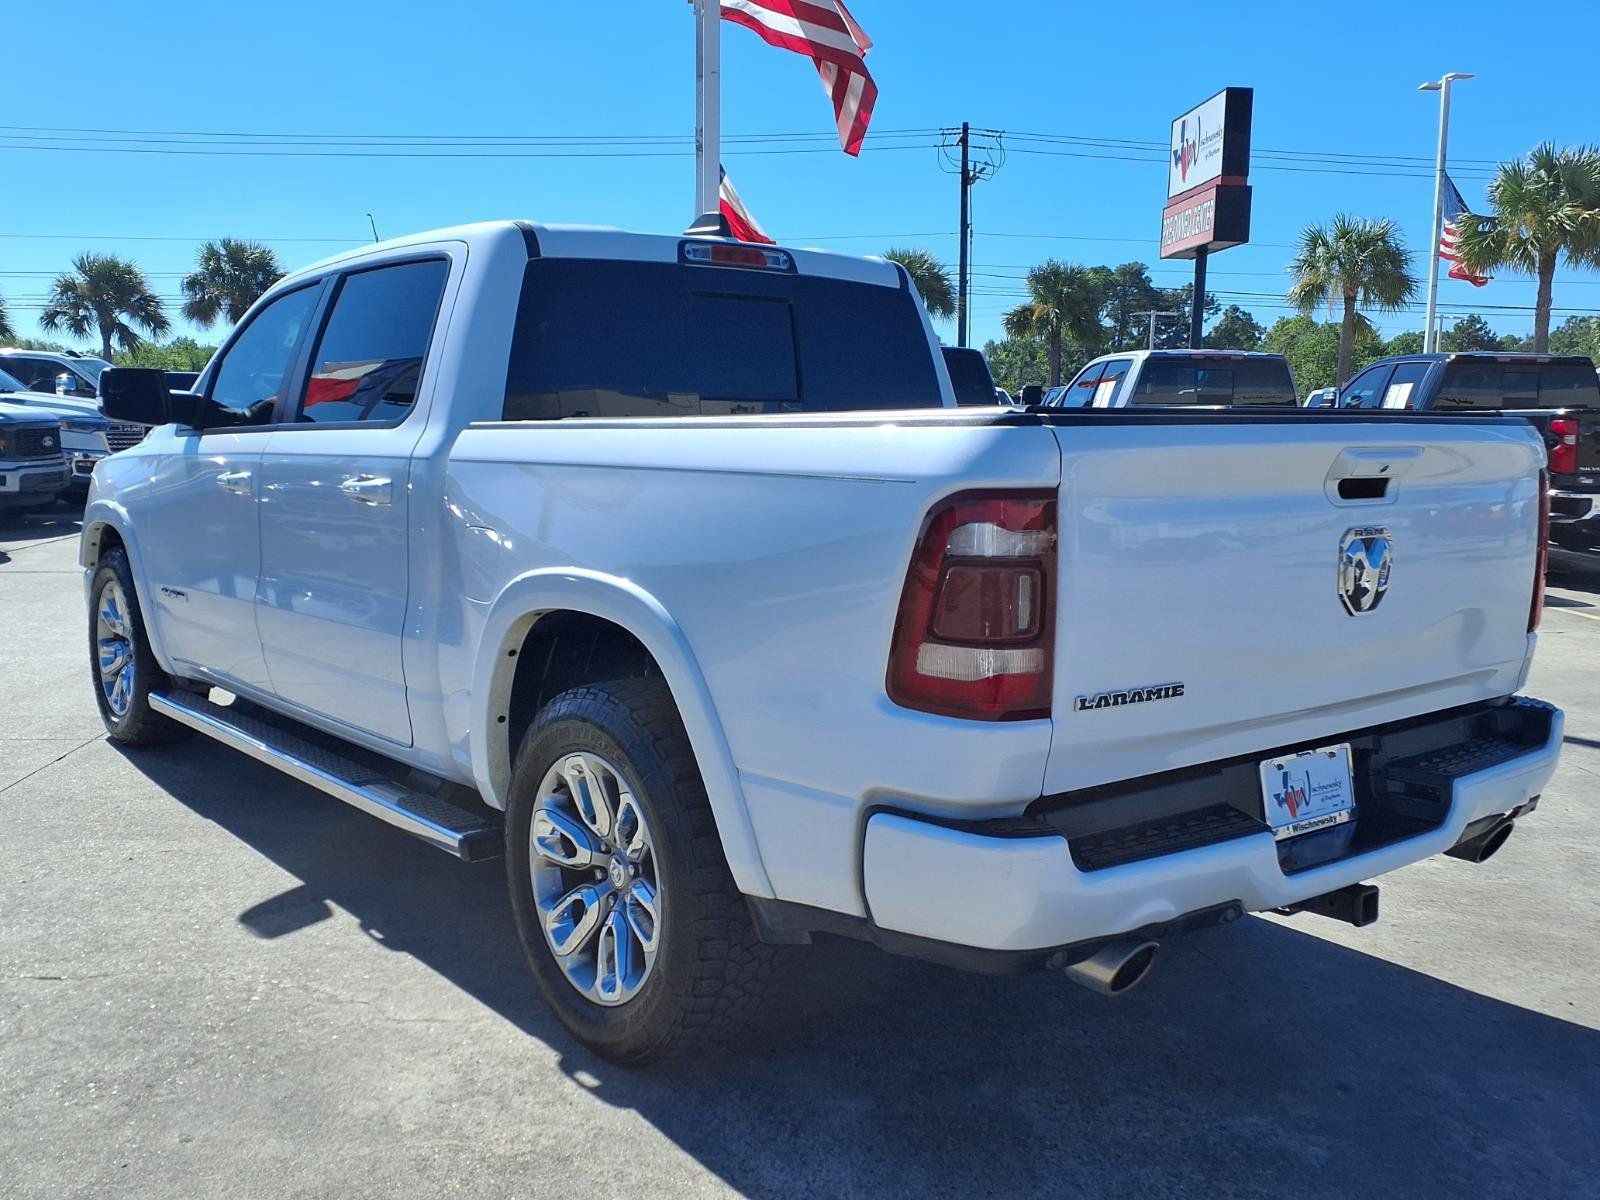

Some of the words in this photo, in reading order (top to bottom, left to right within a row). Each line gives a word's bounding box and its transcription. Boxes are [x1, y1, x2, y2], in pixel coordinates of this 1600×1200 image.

[1192, 199, 1215, 237] CENTER
[1354, 527, 1385, 537] RAM
[1075, 683, 1185, 711] LARAMIE
[1291, 815, 1338, 833] Wischnewsky
